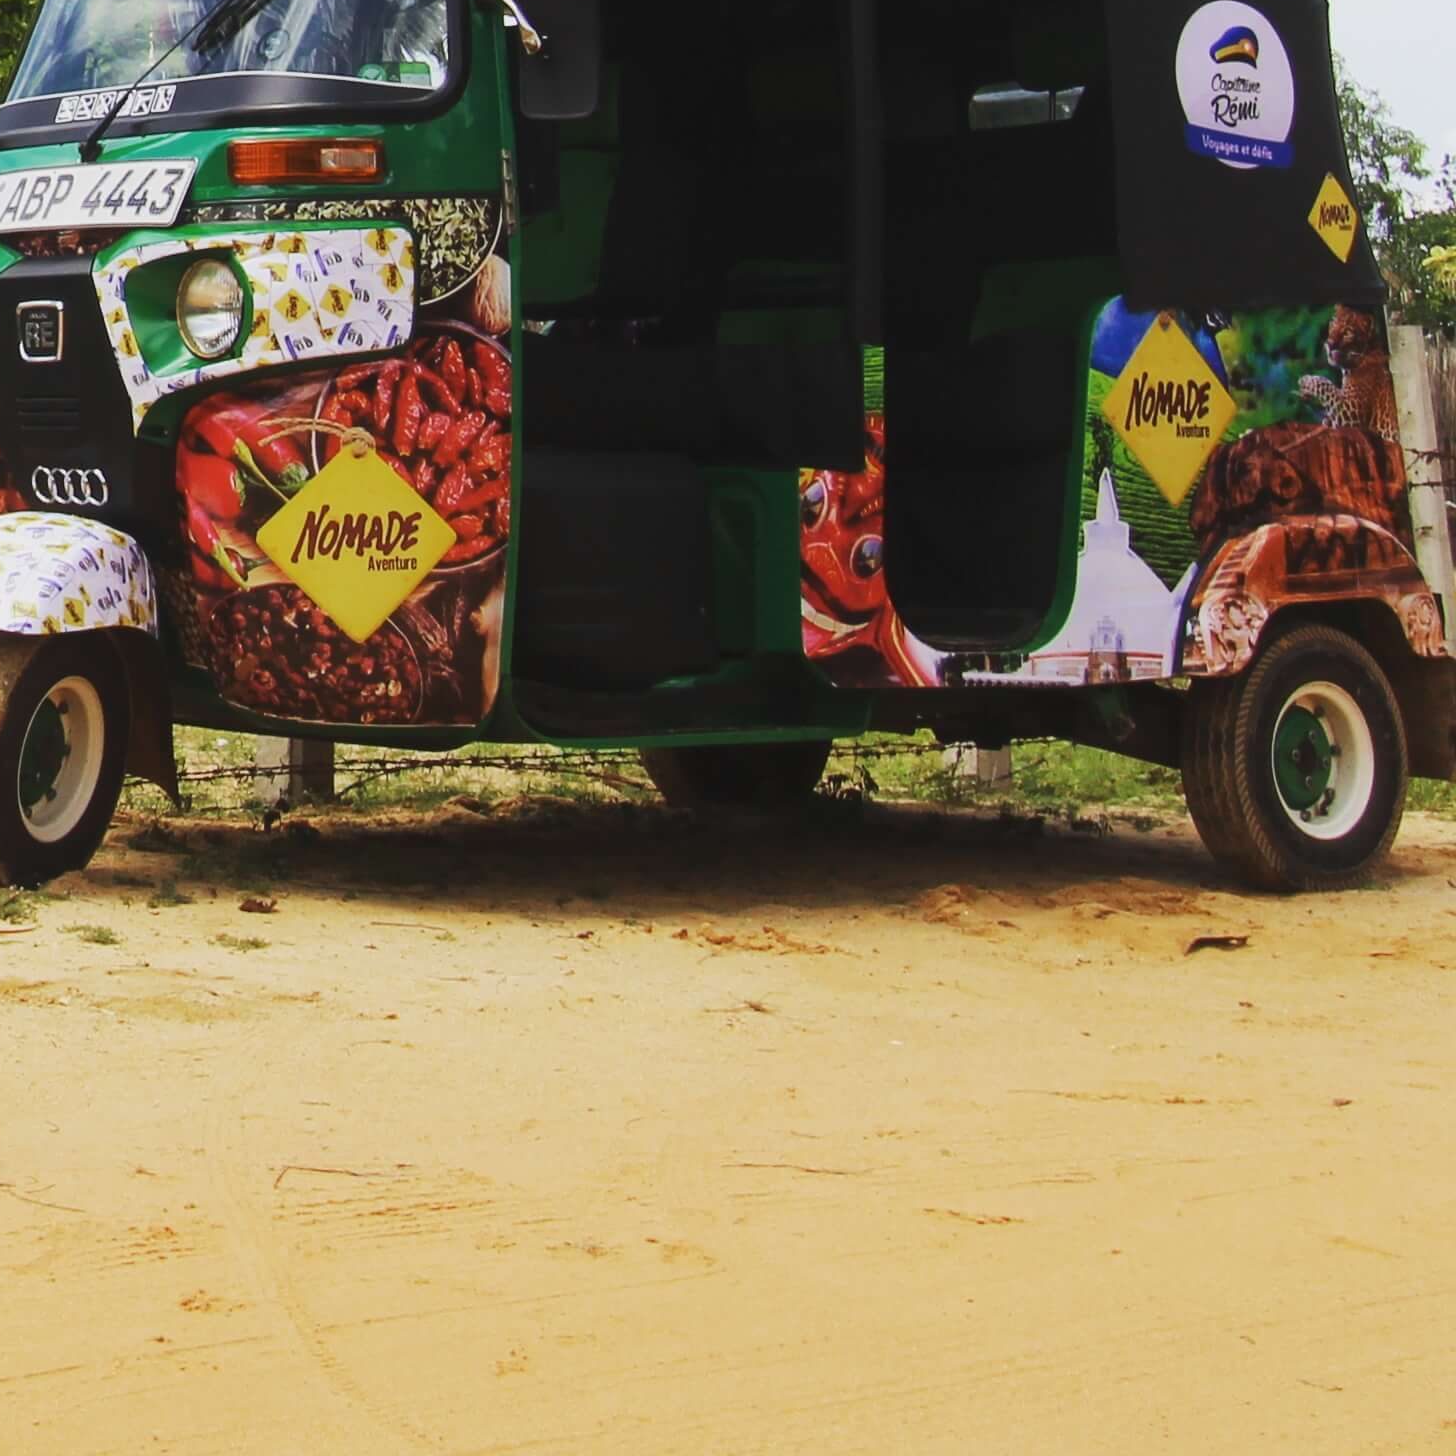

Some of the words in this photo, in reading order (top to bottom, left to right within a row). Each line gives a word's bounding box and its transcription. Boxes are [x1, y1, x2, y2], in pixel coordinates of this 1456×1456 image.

[1210, 94, 1260, 128] Rémi
[1201, 134, 1239, 156] Voyages
[1241, 144, 1250, 156] et
[0, 174, 74, 224] ABP
[80, 168, 184, 217] 4443
[1176, 423, 1210, 439] Aventure
[367, 555, 417, 572] Aventure
